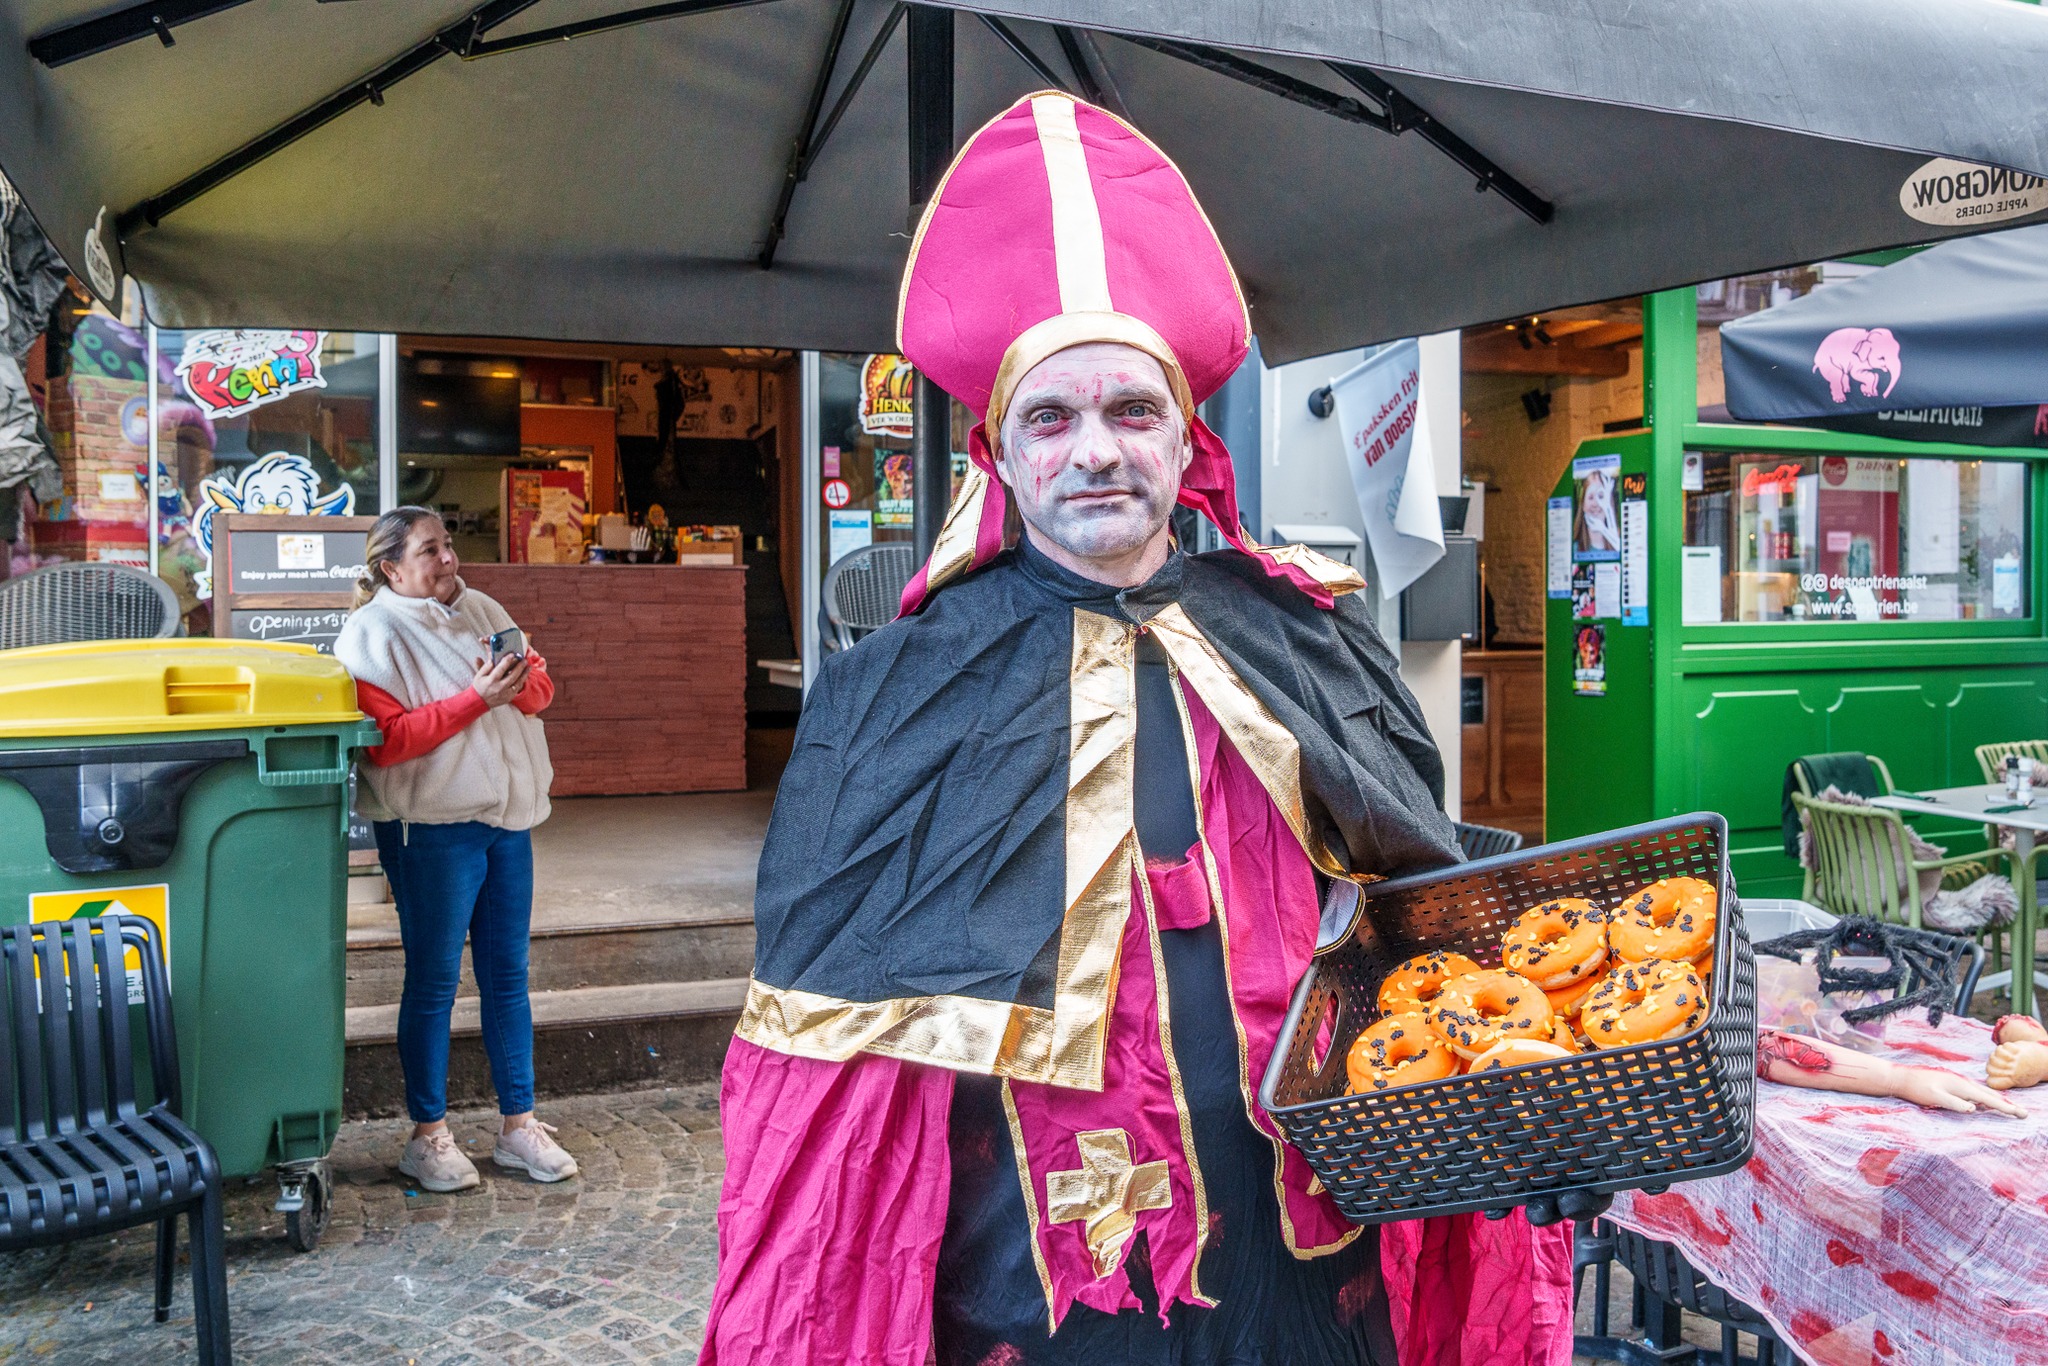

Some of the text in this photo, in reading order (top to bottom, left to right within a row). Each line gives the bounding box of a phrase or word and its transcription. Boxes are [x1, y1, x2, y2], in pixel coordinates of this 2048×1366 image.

[189, 330, 317, 409] Kenny
[1364, 438, 1386, 468] van
[241, 571, 266, 580] Enjoy
[267, 572, 287, 580] your
[287, 571, 309, 579] meal
[310, 571, 328, 579] with
